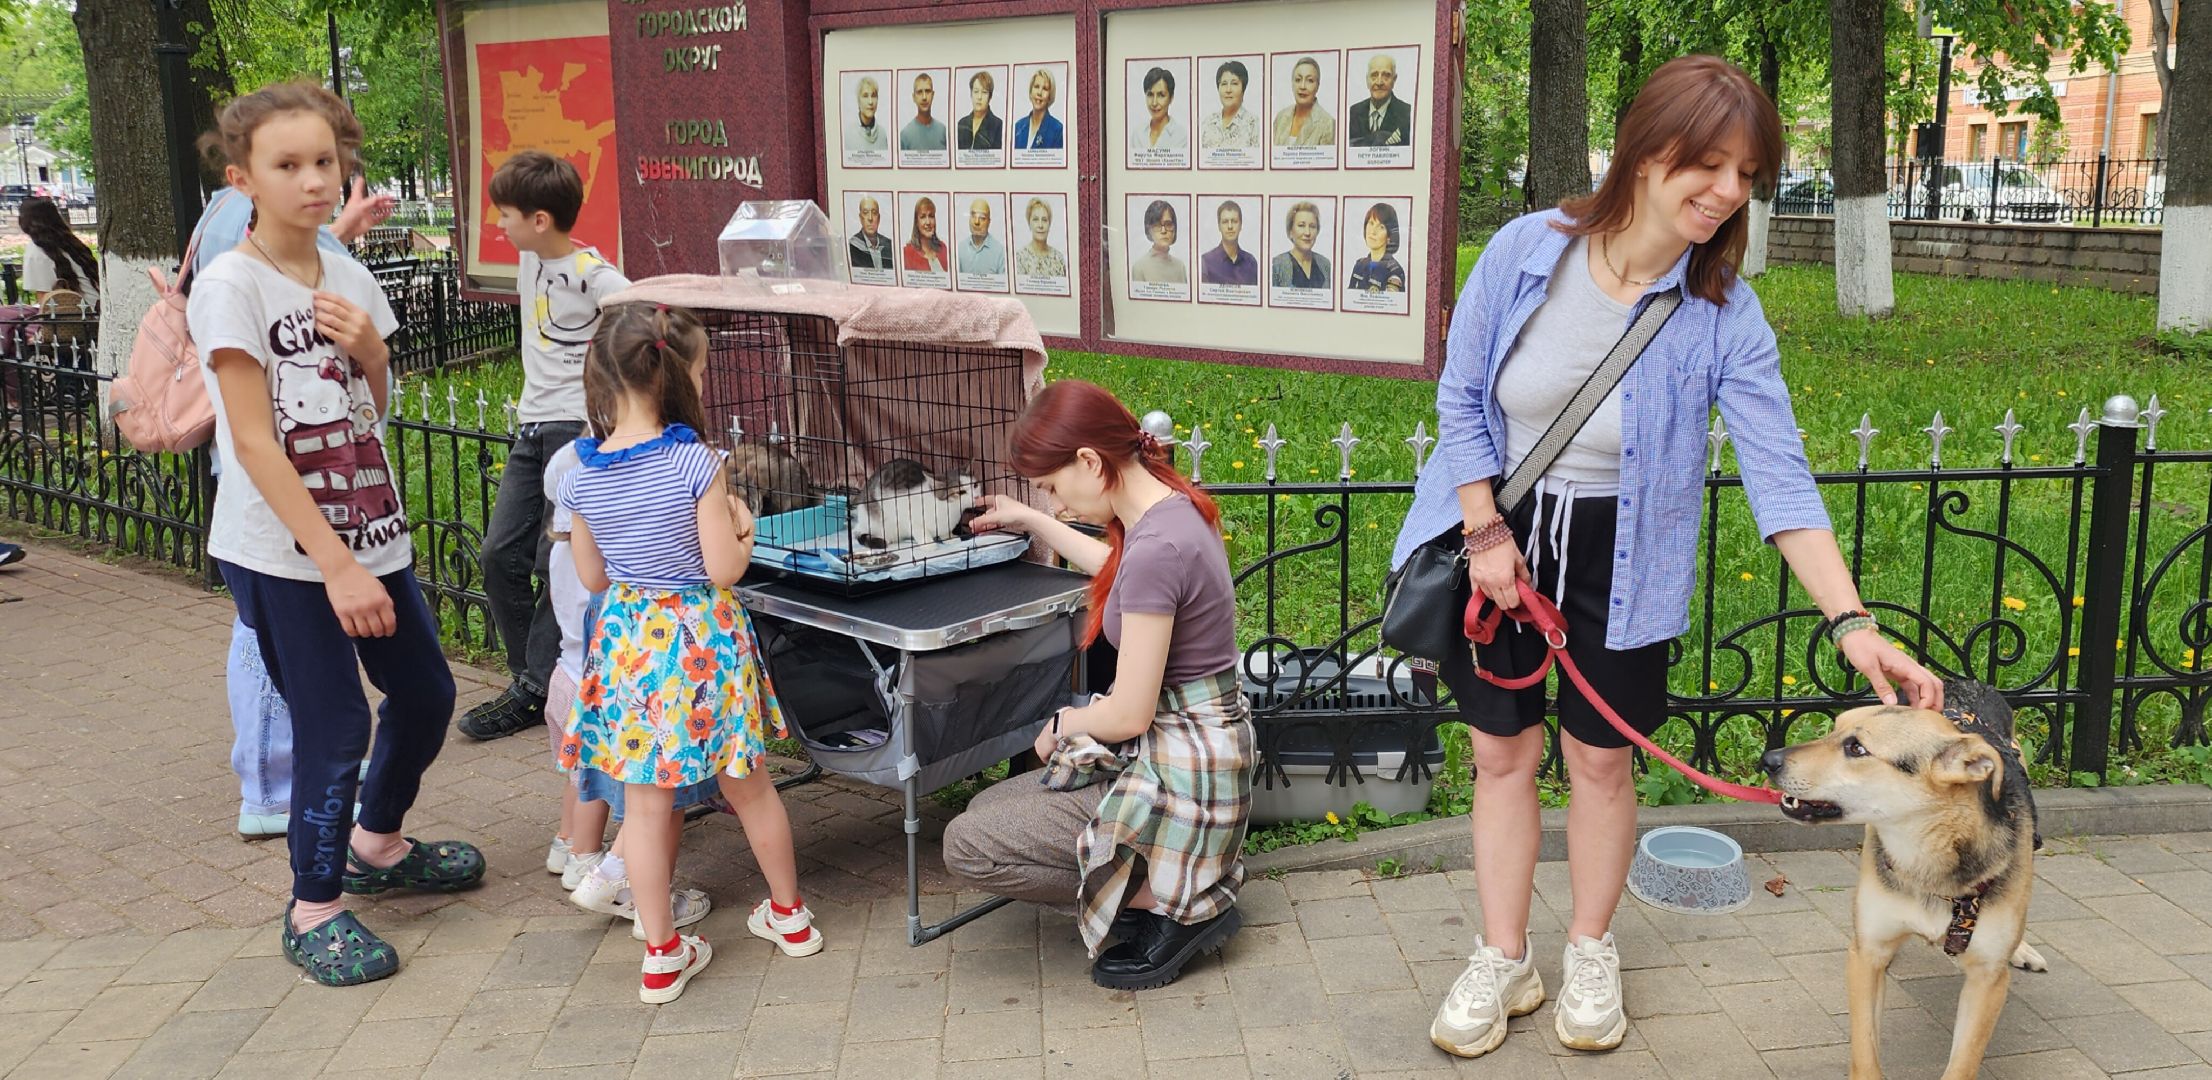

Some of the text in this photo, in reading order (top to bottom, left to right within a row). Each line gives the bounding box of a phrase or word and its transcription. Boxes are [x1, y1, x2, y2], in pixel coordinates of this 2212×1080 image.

[637, 0, 747, 38] ГОРОДСКОЙ
[663, 44, 722, 73] ОКРУГ
[665, 119, 728, 147] ГОРОД
[638, 155, 763, 185] ЗВЕНИГОРОД
[298, 784, 345, 879] benetton
